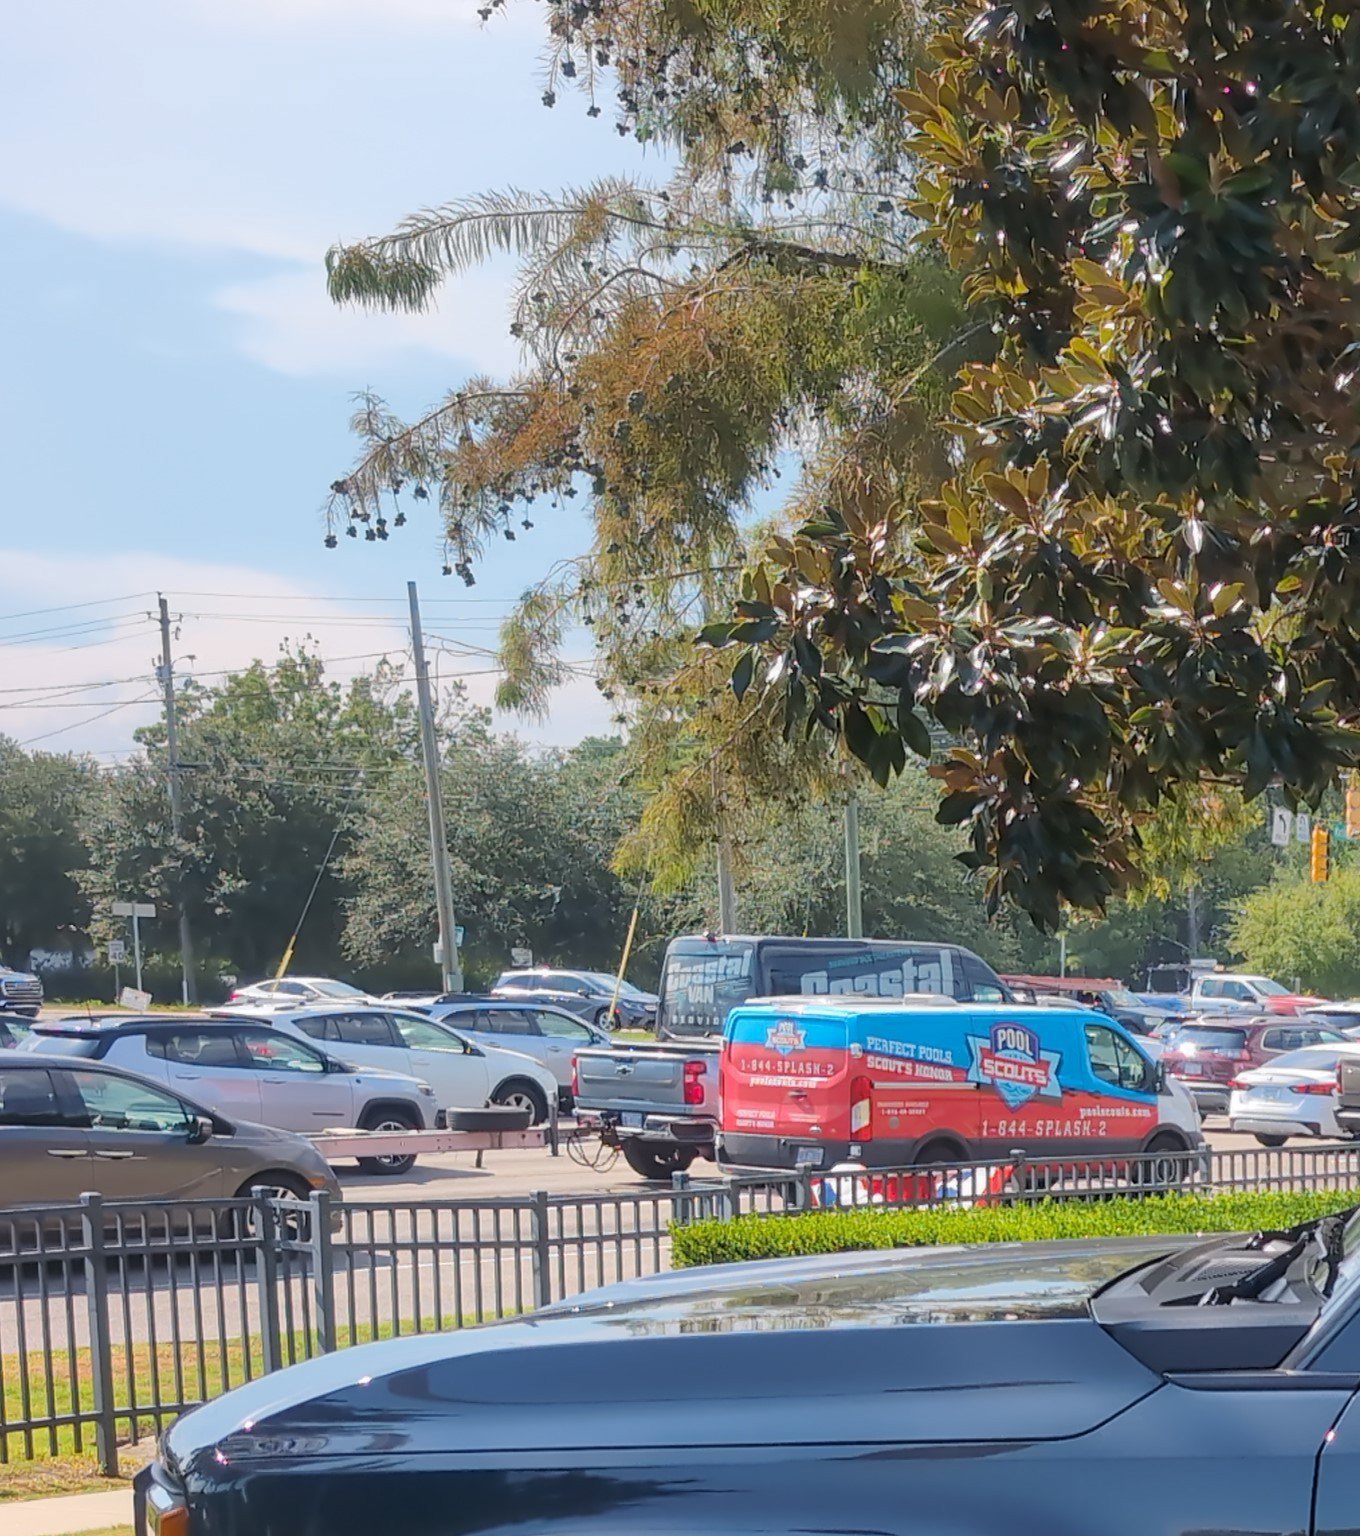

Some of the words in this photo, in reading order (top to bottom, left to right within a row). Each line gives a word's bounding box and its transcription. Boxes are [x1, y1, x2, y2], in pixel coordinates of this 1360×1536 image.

[688, 984, 714, 1003] VAN
[866, 1036, 917, 1056] PERFECT
[997, 1027, 1034, 1057] POOL
[740, 1058, 835, 1076] 1-844-SPLASH-2
[866, 1055, 914, 1076] SCOUT'S
[914, 1064, 953, 1081] HONOR
[983, 1058, 1048, 1085] SCOUTS
[1079, 1106, 1151, 1118] poolscouts.com
[981, 1119, 1107, 1137] 1-844-SPLASH-2
